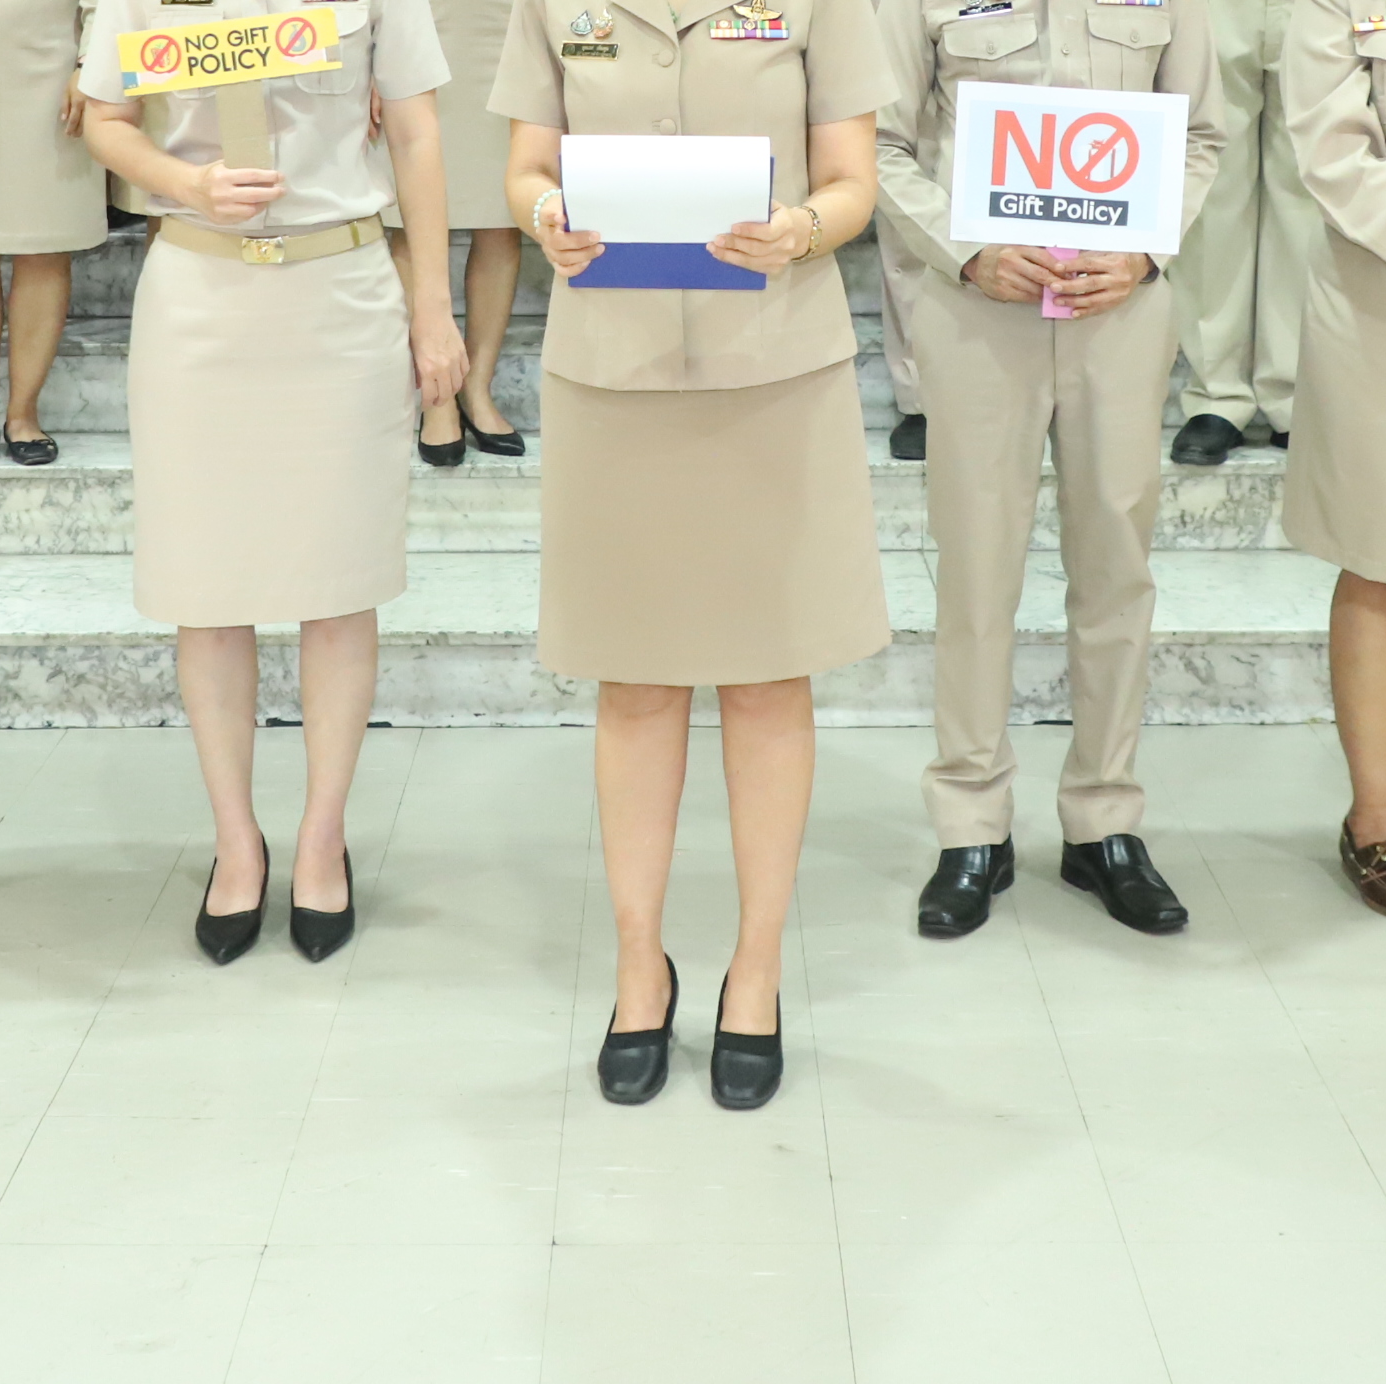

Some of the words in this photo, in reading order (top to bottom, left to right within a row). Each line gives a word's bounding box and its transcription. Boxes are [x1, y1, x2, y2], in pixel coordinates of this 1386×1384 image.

[184, 32, 219, 53] NO
[227, 26, 269, 47] GIFT
[187, 46, 271, 76] POLICY
[999, 194, 1044, 217] Gift
[1053, 198, 1123, 226] Policy
